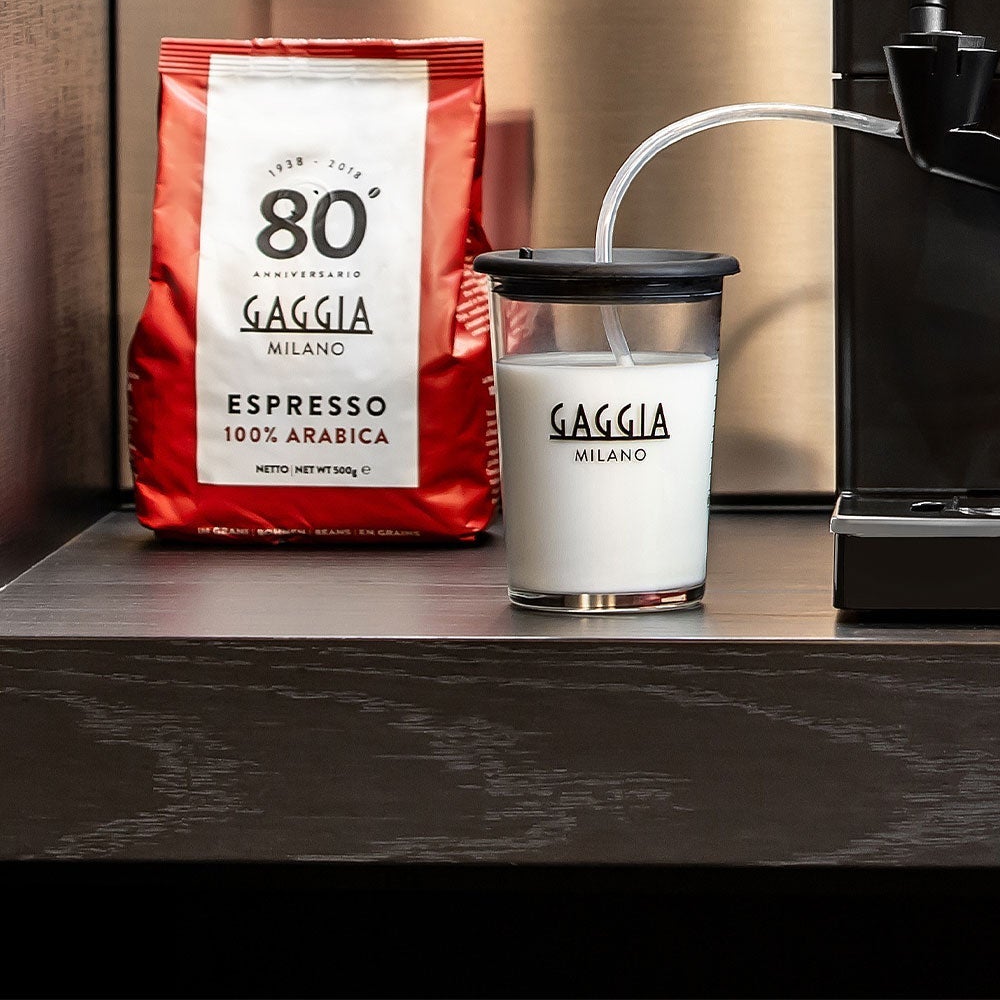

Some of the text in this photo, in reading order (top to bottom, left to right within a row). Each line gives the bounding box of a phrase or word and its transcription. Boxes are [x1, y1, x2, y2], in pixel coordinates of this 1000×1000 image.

[268, 156, 304, 177] 1938
[328, 159, 362, 179] 2018
[256, 188, 368, 260] 80
[252, 271, 362, 279] ANNIVERSARIO
[240, 295, 373, 334] GAGGIA
[267, 341, 345, 356] MILANO
[227, 394, 387, 417] ESPRESSO
[549, 402, 670, 440] GAGGIA
[223, 426, 389, 445] 100% ARABICA
[575, 448, 647, 461] MILANO
[256, 465, 289, 474] NETTO
[294, 466, 314, 474] NET
[316, 466, 332, 474] WT
[332, 466, 357, 478] 500g
